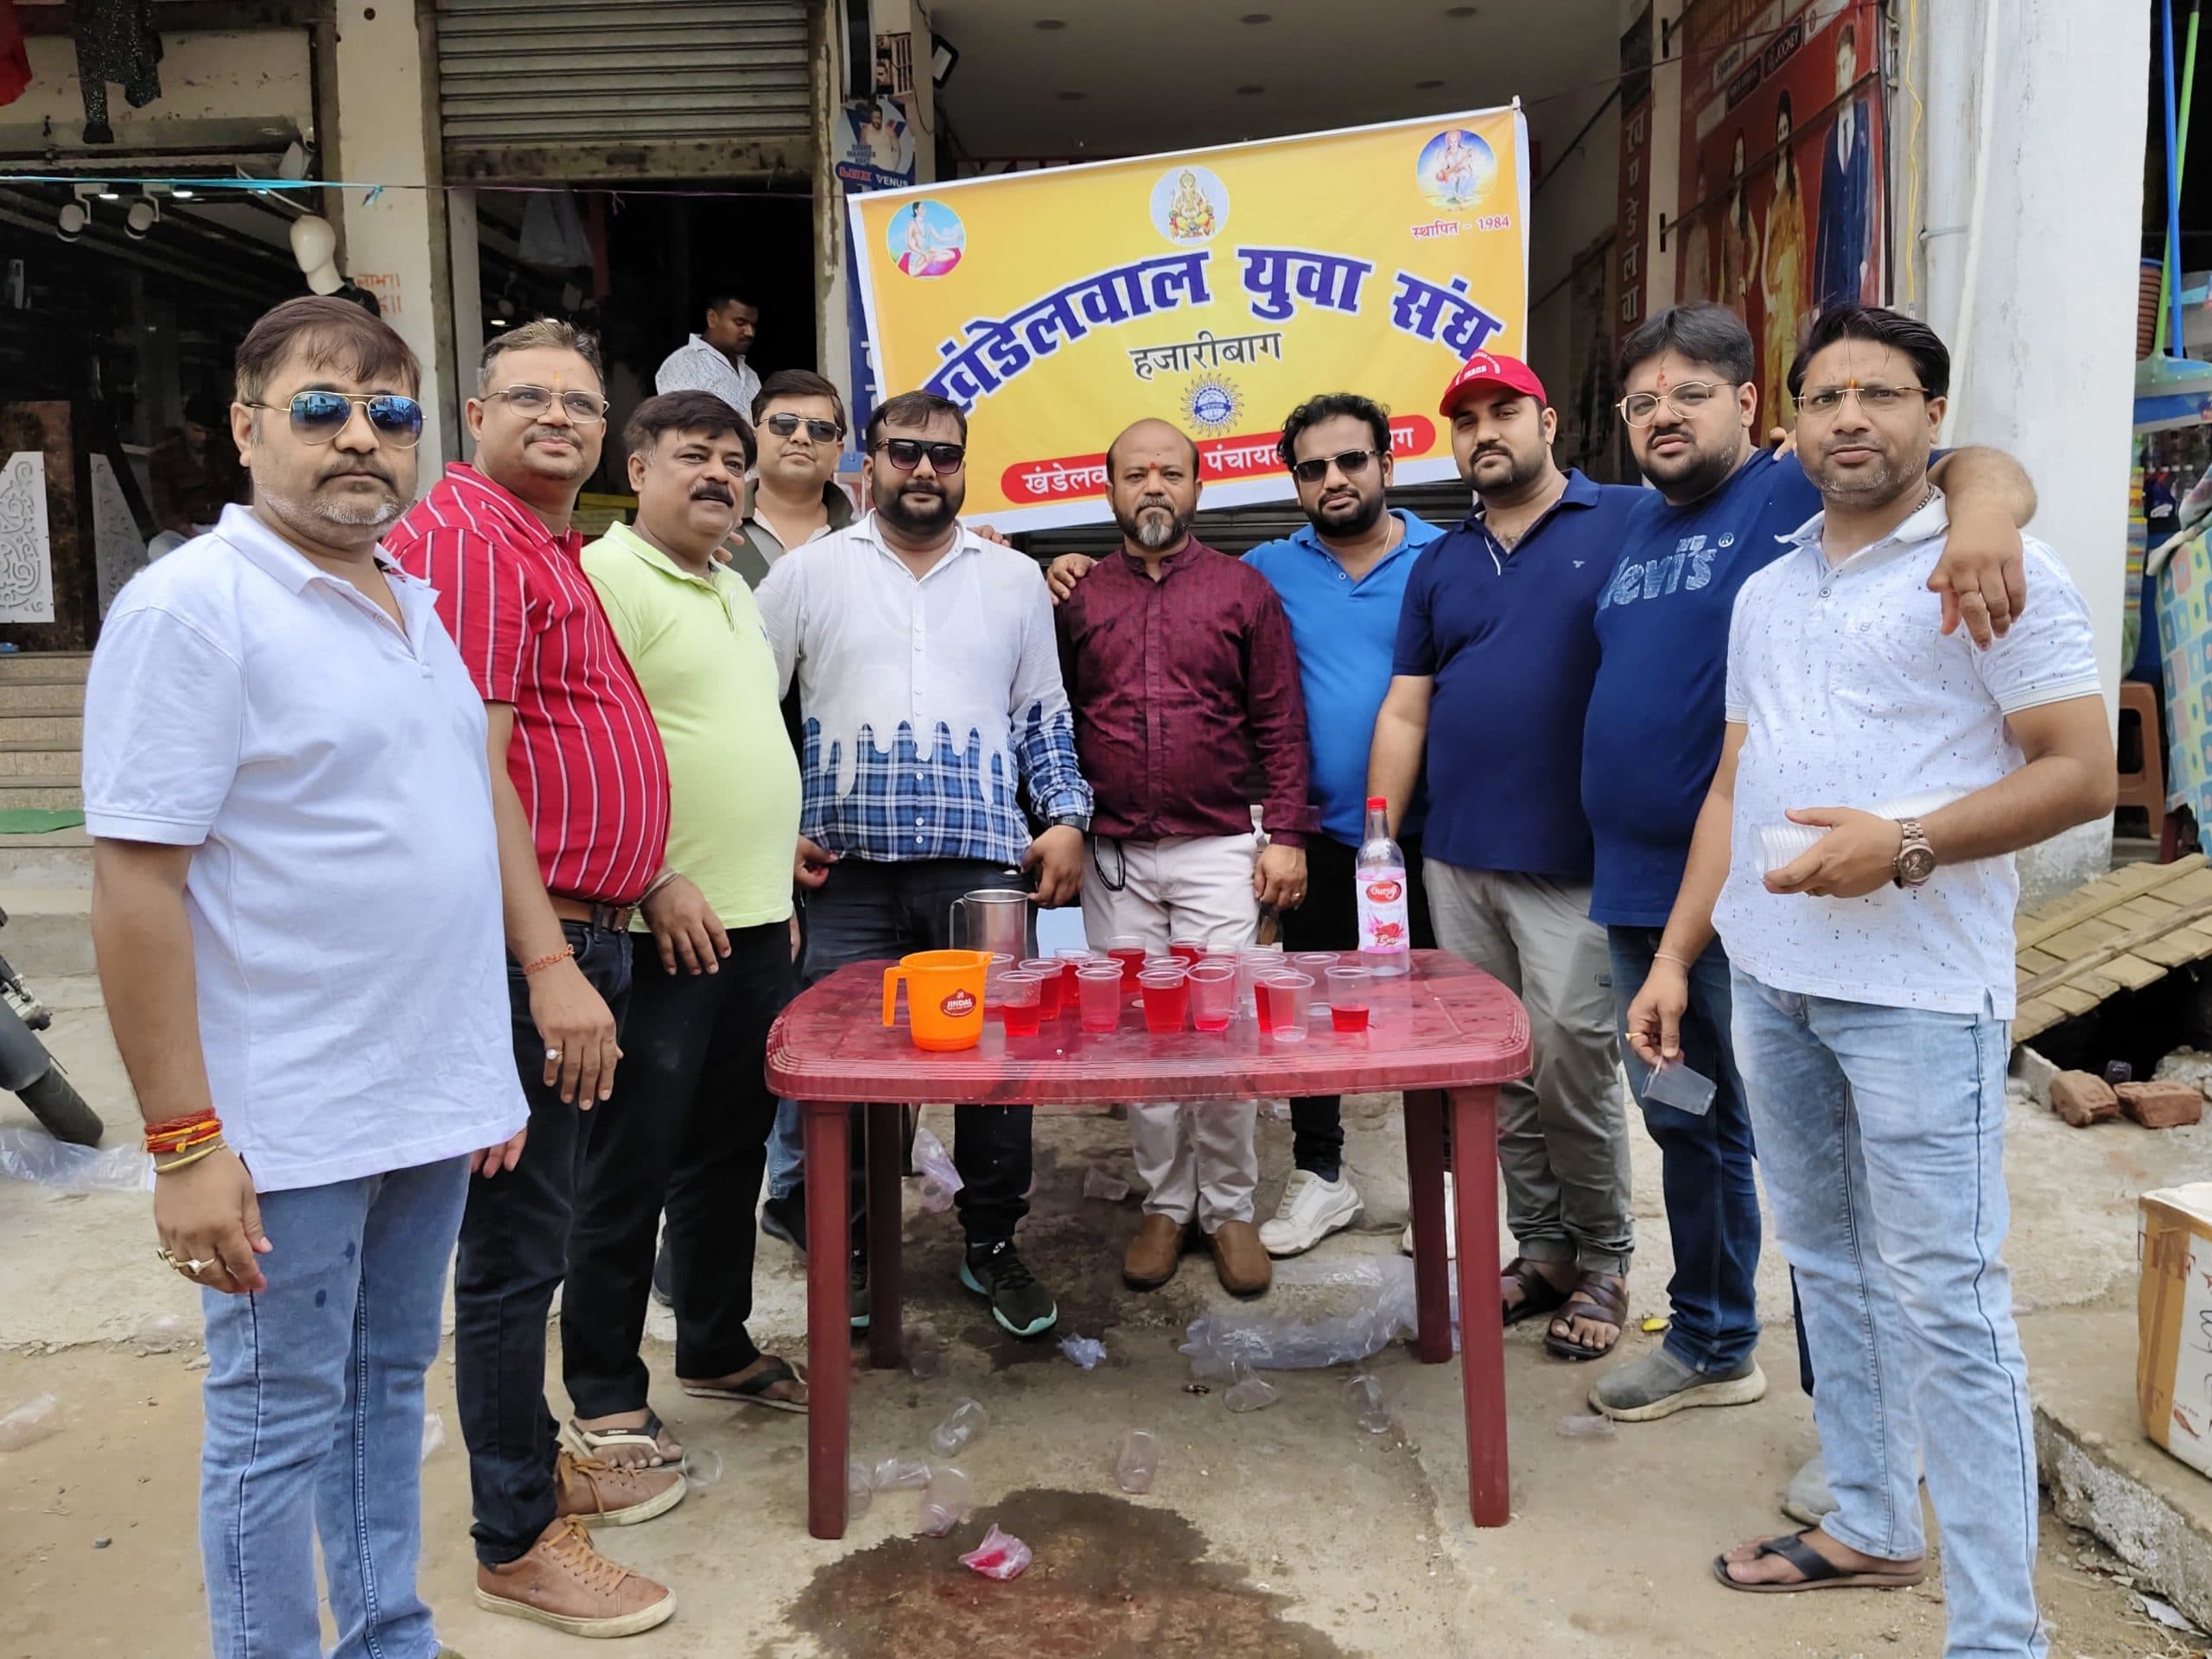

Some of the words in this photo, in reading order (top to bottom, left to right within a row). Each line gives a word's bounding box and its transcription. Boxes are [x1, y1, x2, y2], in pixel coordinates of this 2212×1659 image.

[874, 174, 910, 188] VENUS
[1411, 219, 1459, 238] स्थापित
[1478, 215, 1510, 231] 1984
[922, 251, 1211, 413] खंडेलवाल
[1237, 248, 1373, 321] युवा
[1392, 271, 1503, 362] संघ
[1129, 330, 1282, 381] हजारीबाग
[1021, 461, 1109, 496] खंडेलव
[946, 997, 974, 1011] JINDAL
